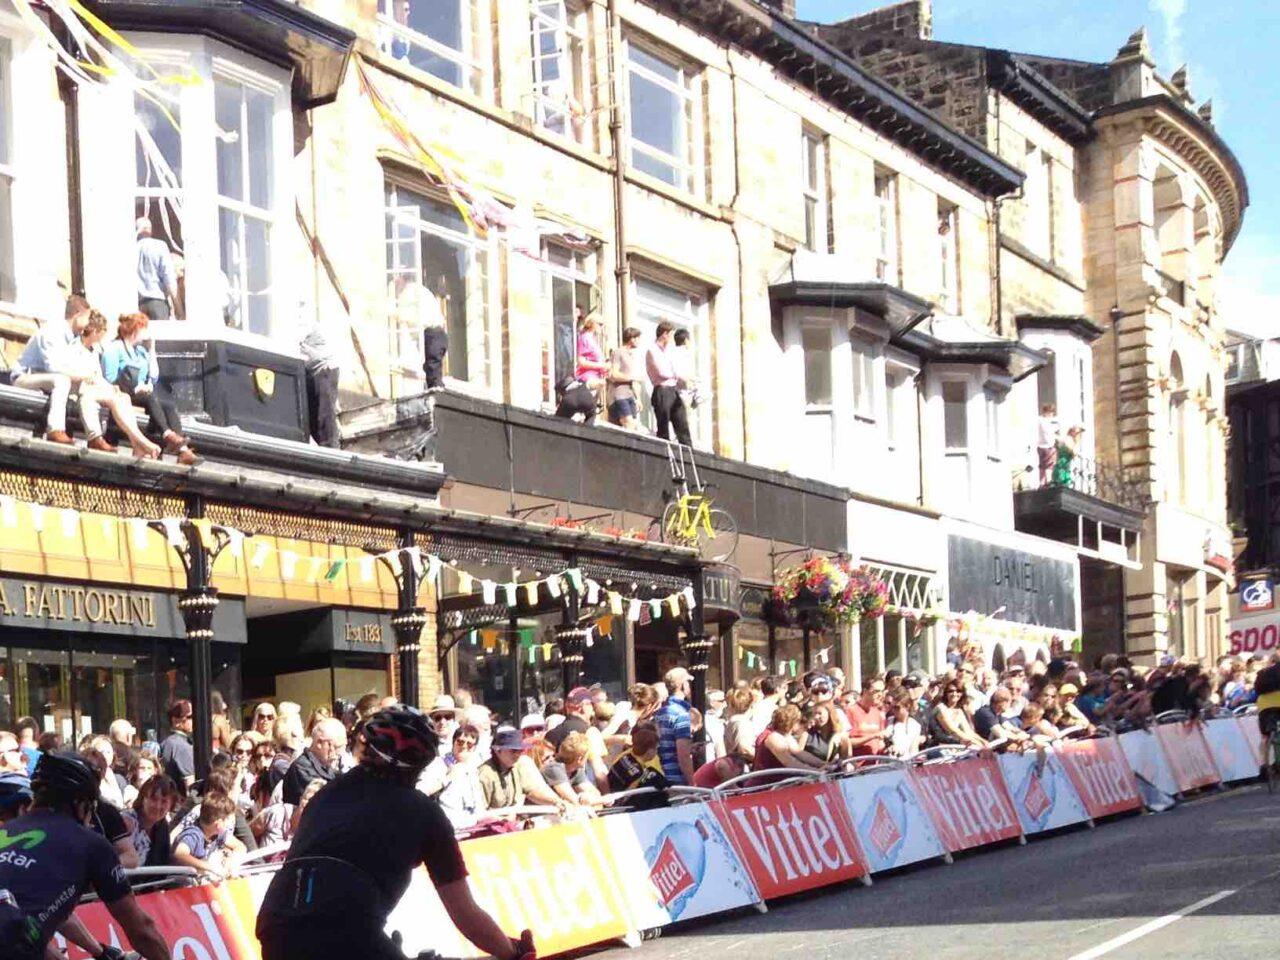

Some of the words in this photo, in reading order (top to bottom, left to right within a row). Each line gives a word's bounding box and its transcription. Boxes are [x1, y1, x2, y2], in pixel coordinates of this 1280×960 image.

[23, 584, 157, 628] FATTORINI
[921, 767, 1012, 840] Vittel
[732, 794, 853, 884] Vittel
[38, 884, 77, 923] movistar
